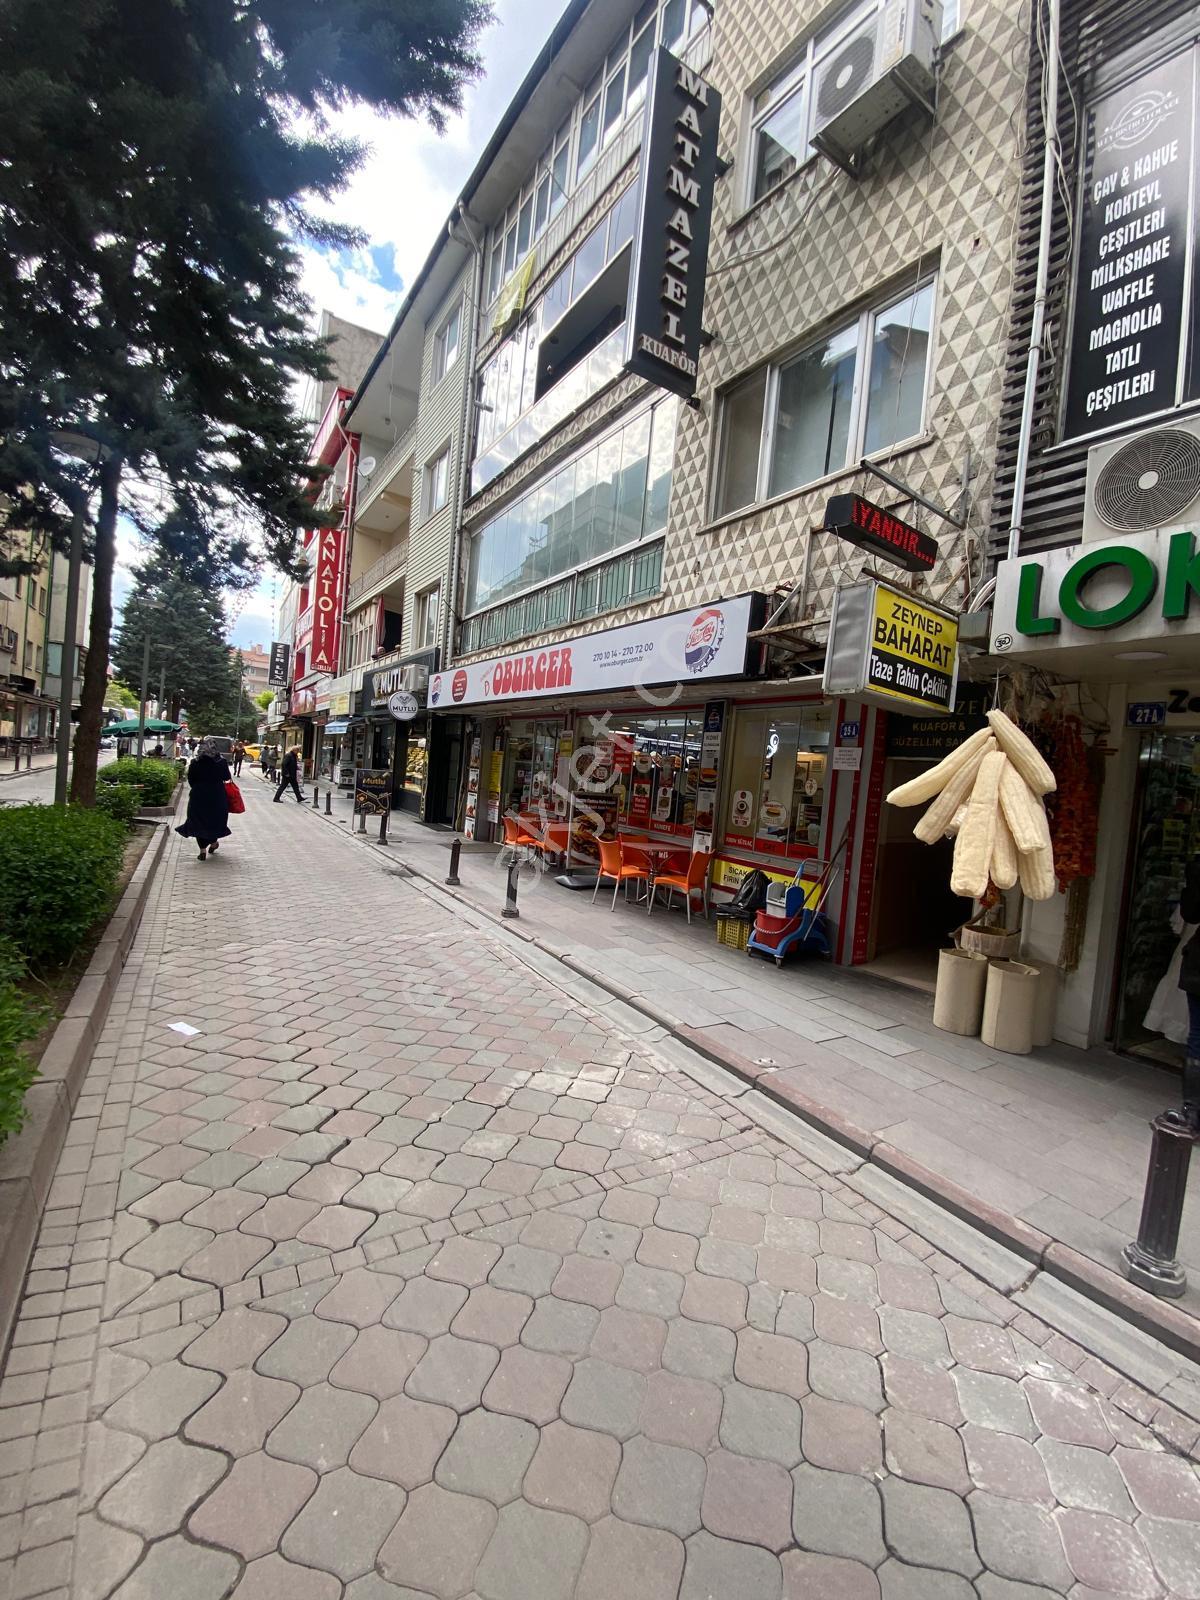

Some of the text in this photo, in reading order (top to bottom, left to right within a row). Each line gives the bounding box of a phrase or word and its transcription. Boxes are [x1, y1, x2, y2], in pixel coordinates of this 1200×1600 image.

[665, 64, 708, 344] MATMAZEL
[1093, 172, 1118, 204] ÇAY
[1120, 166, 1130, 187] &
[1105, 180, 1161, 224] KOKTEYL
[1099, 207, 1165, 260] ÇEŞİTLERİ
[1102, 274, 1154, 315] WAFFLE
[641, 333, 697, 376] KUAFÖR
[1106, 342, 1141, 374] TATLI
[1086, 370, 1155, 417] ÇEŞİTLERİ
[891, 602, 943, 637] ZEYNEP
[592, 652, 603, 662] 270
[604, 651, 610, 660] 10
[611, 649, 618, 658] 14
[622, 646, 634, 657] 270
[635, 644, 644, 653] 72
[644, 642, 654, 652] 00
[874, 616, 951, 668] BAHARAT
[493, 647, 573, 696] OBURGER
[871, 655, 948, 699] Taze Tahin Çekilir
[723, 874, 739, 885] FIRIN
